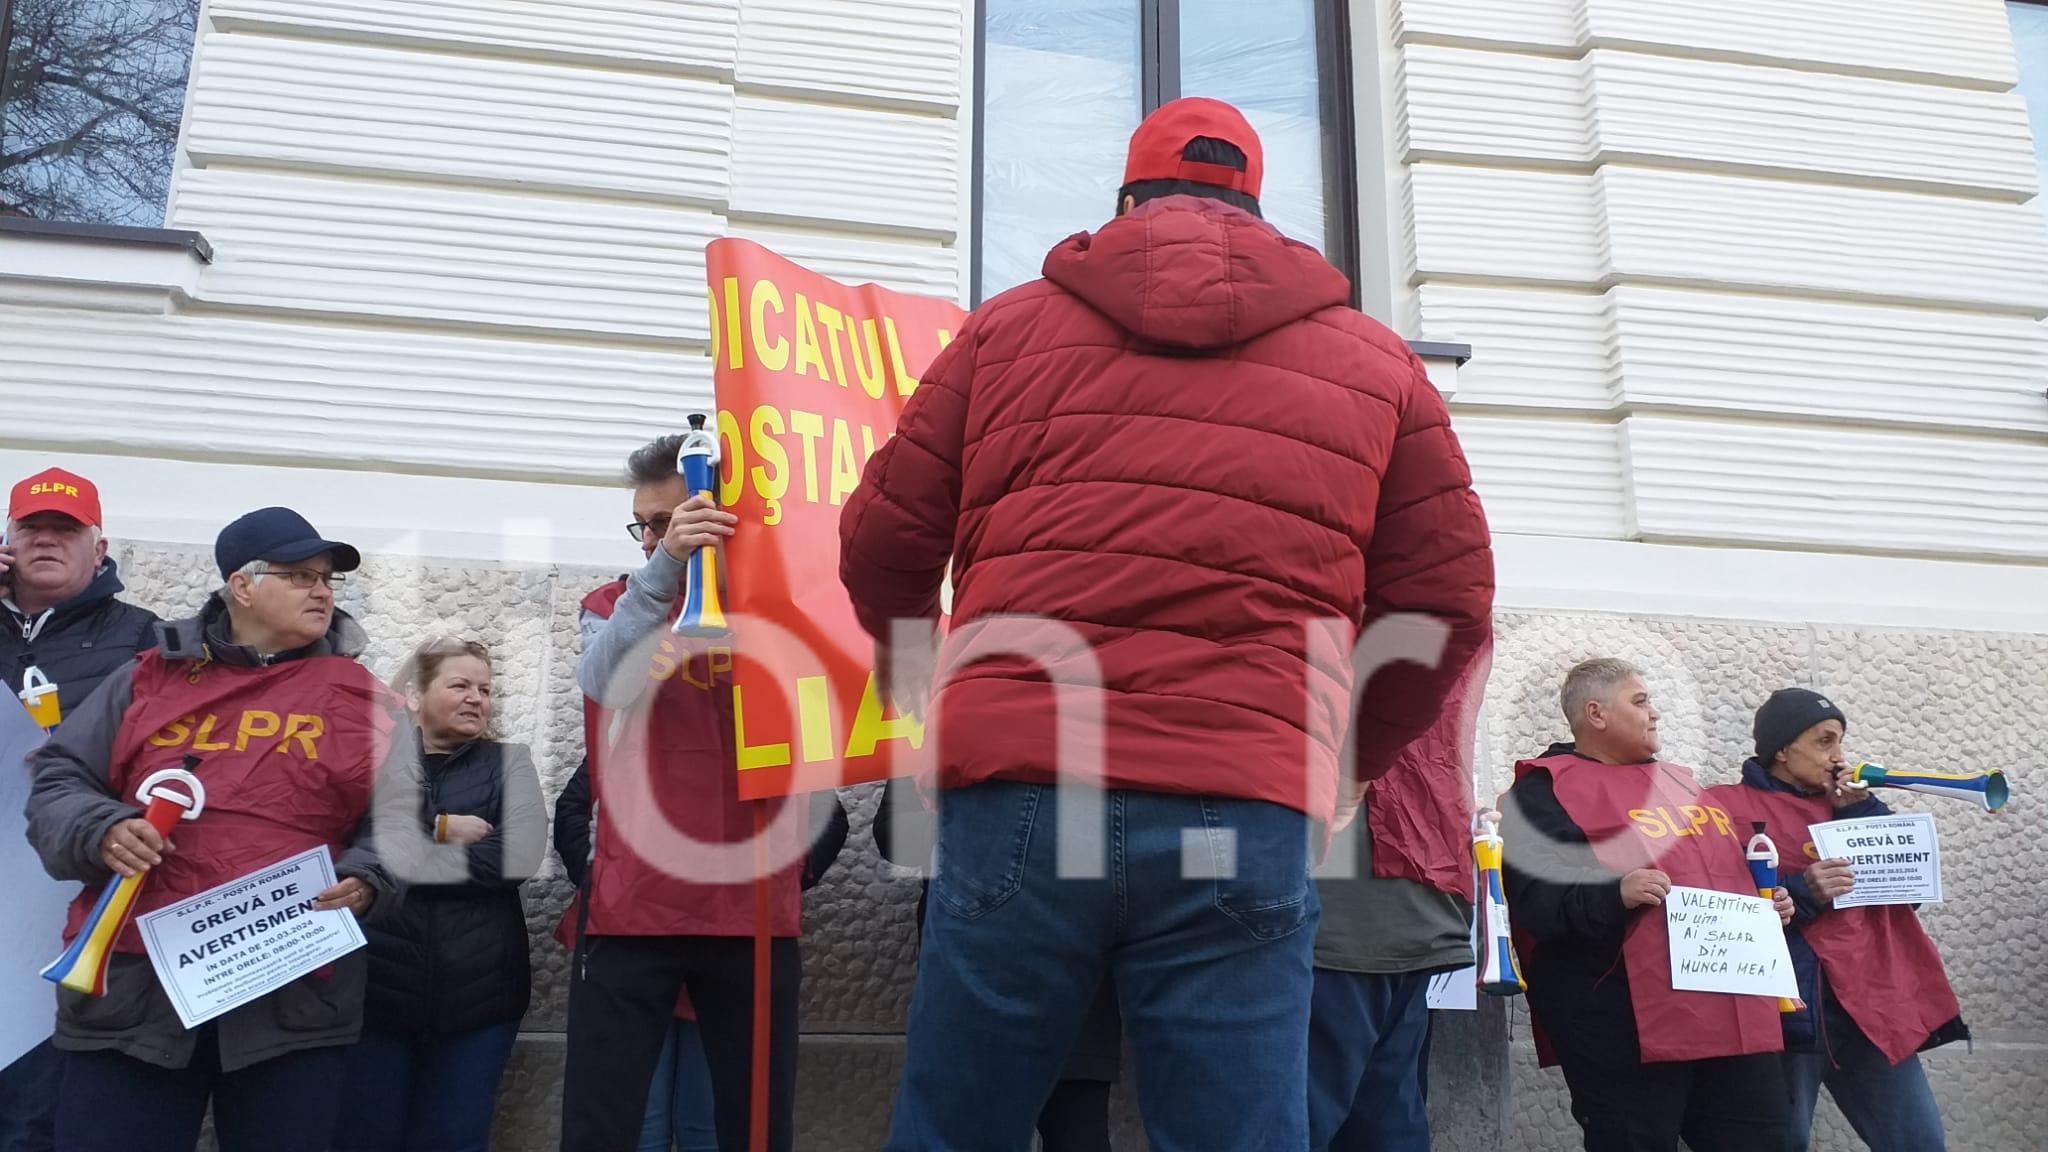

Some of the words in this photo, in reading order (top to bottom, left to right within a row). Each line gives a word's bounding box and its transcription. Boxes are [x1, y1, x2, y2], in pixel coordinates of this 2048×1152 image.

[30, 482, 79, 498] SLPR
[150, 710, 325, 759] SLPR
[1628, 805, 1739, 840] SLPR
[1897, 834, 1916, 845] DE
[1840, 852, 1930, 865] VERTISMENT
[177, 900, 215, 917] S.L.P.R.
[191, 893, 266, 934] GREVĂ
[271, 883, 300, 902] DE
[1670, 912, 1687, 923] NU
[219, 950, 247, 969] DATA
[248, 943, 262, 954] DE
[263, 919, 314, 947] 20.03.2024
[203, 968, 235, 986] ÎNTRE
[237, 951, 271, 972] ORELE:
[272, 925, 326, 955] 08:00-10:00
[1680, 958, 1728, 975] MUNCA
